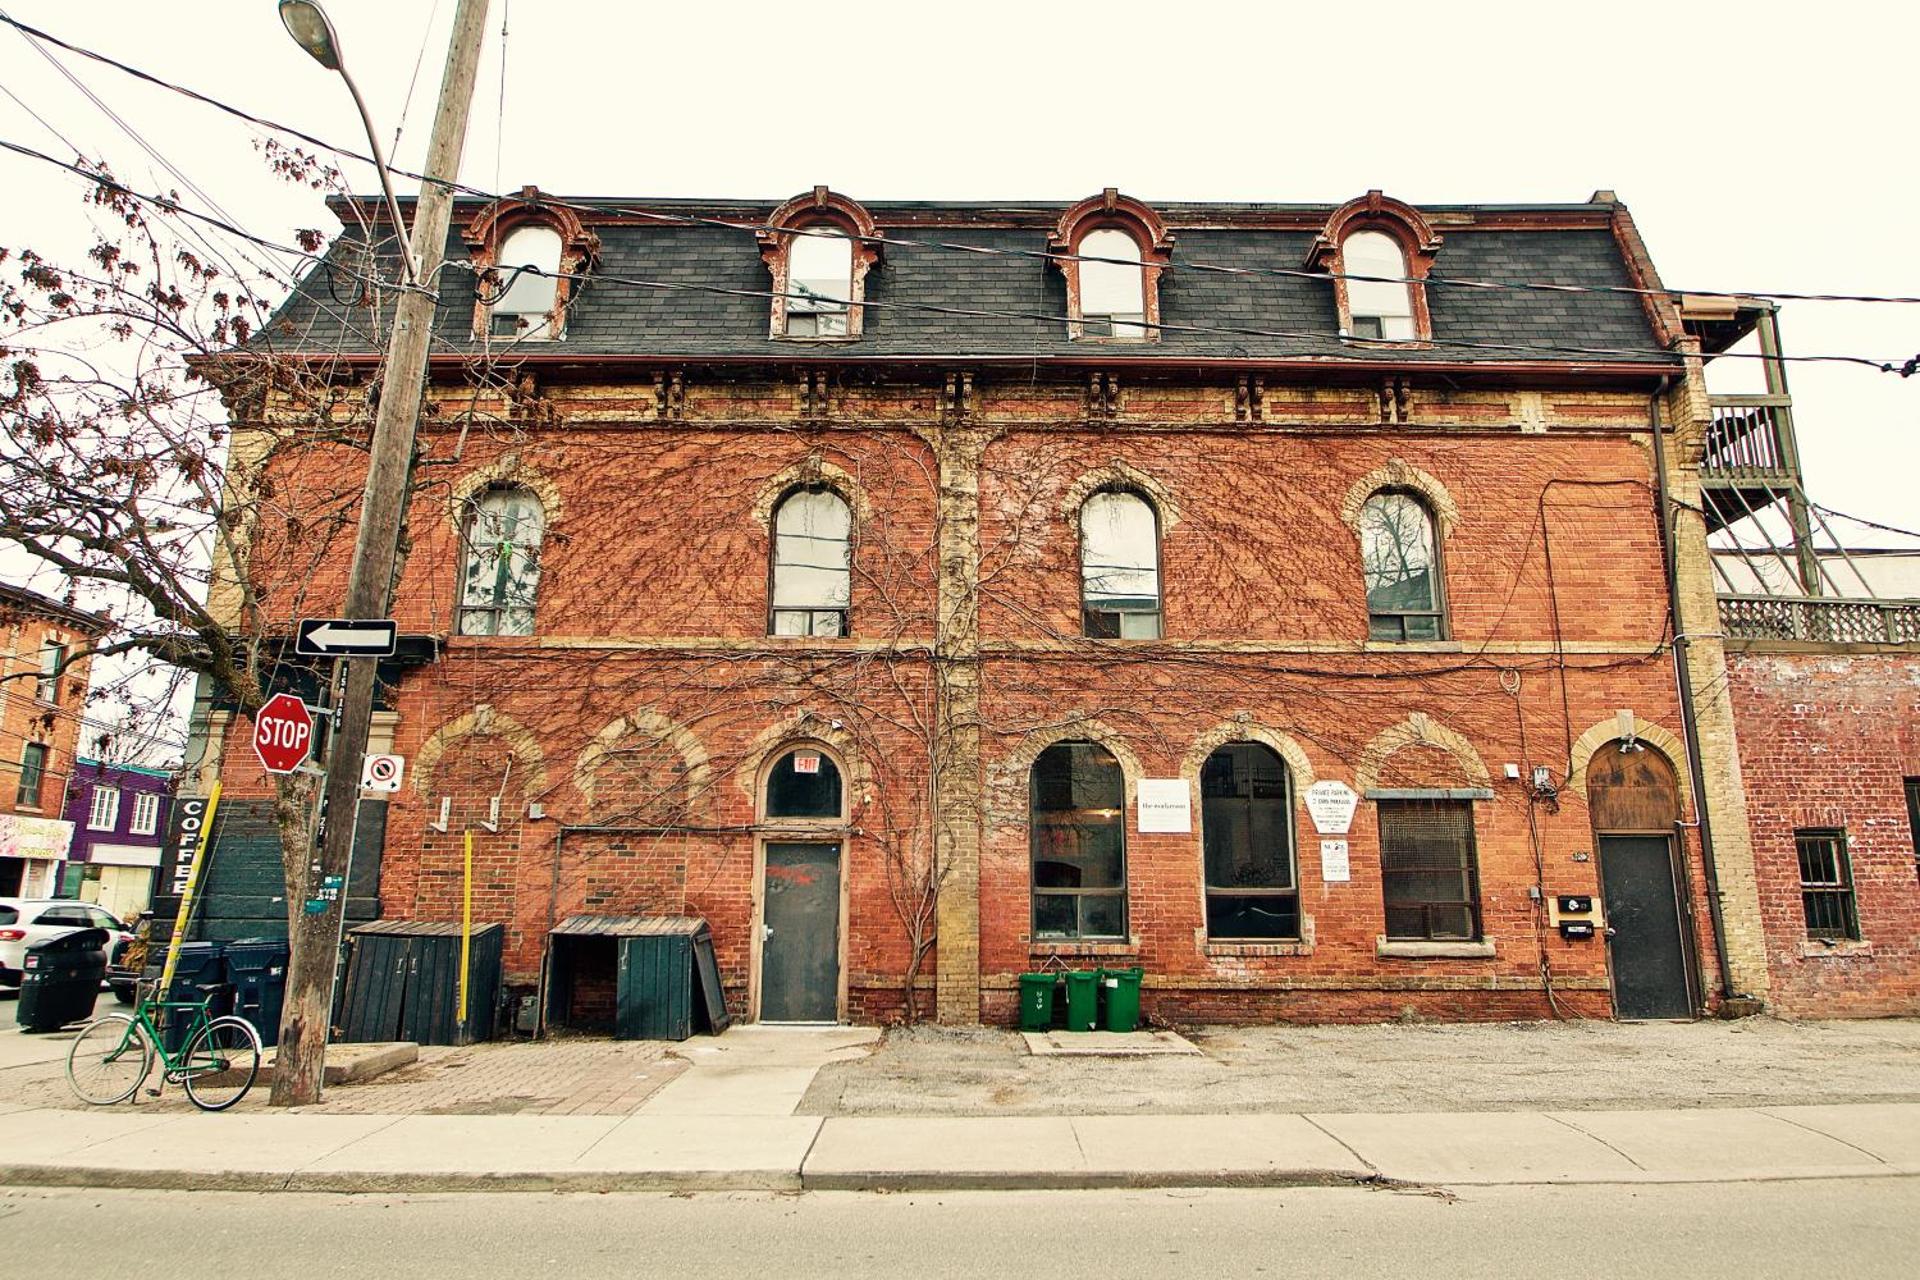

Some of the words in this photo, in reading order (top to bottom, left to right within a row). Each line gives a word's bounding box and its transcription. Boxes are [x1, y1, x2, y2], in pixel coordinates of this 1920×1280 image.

[259, 716, 309, 750] STOP
[798, 758, 818, 771] EXIT
[172, 801, 203, 894] COFFEE
